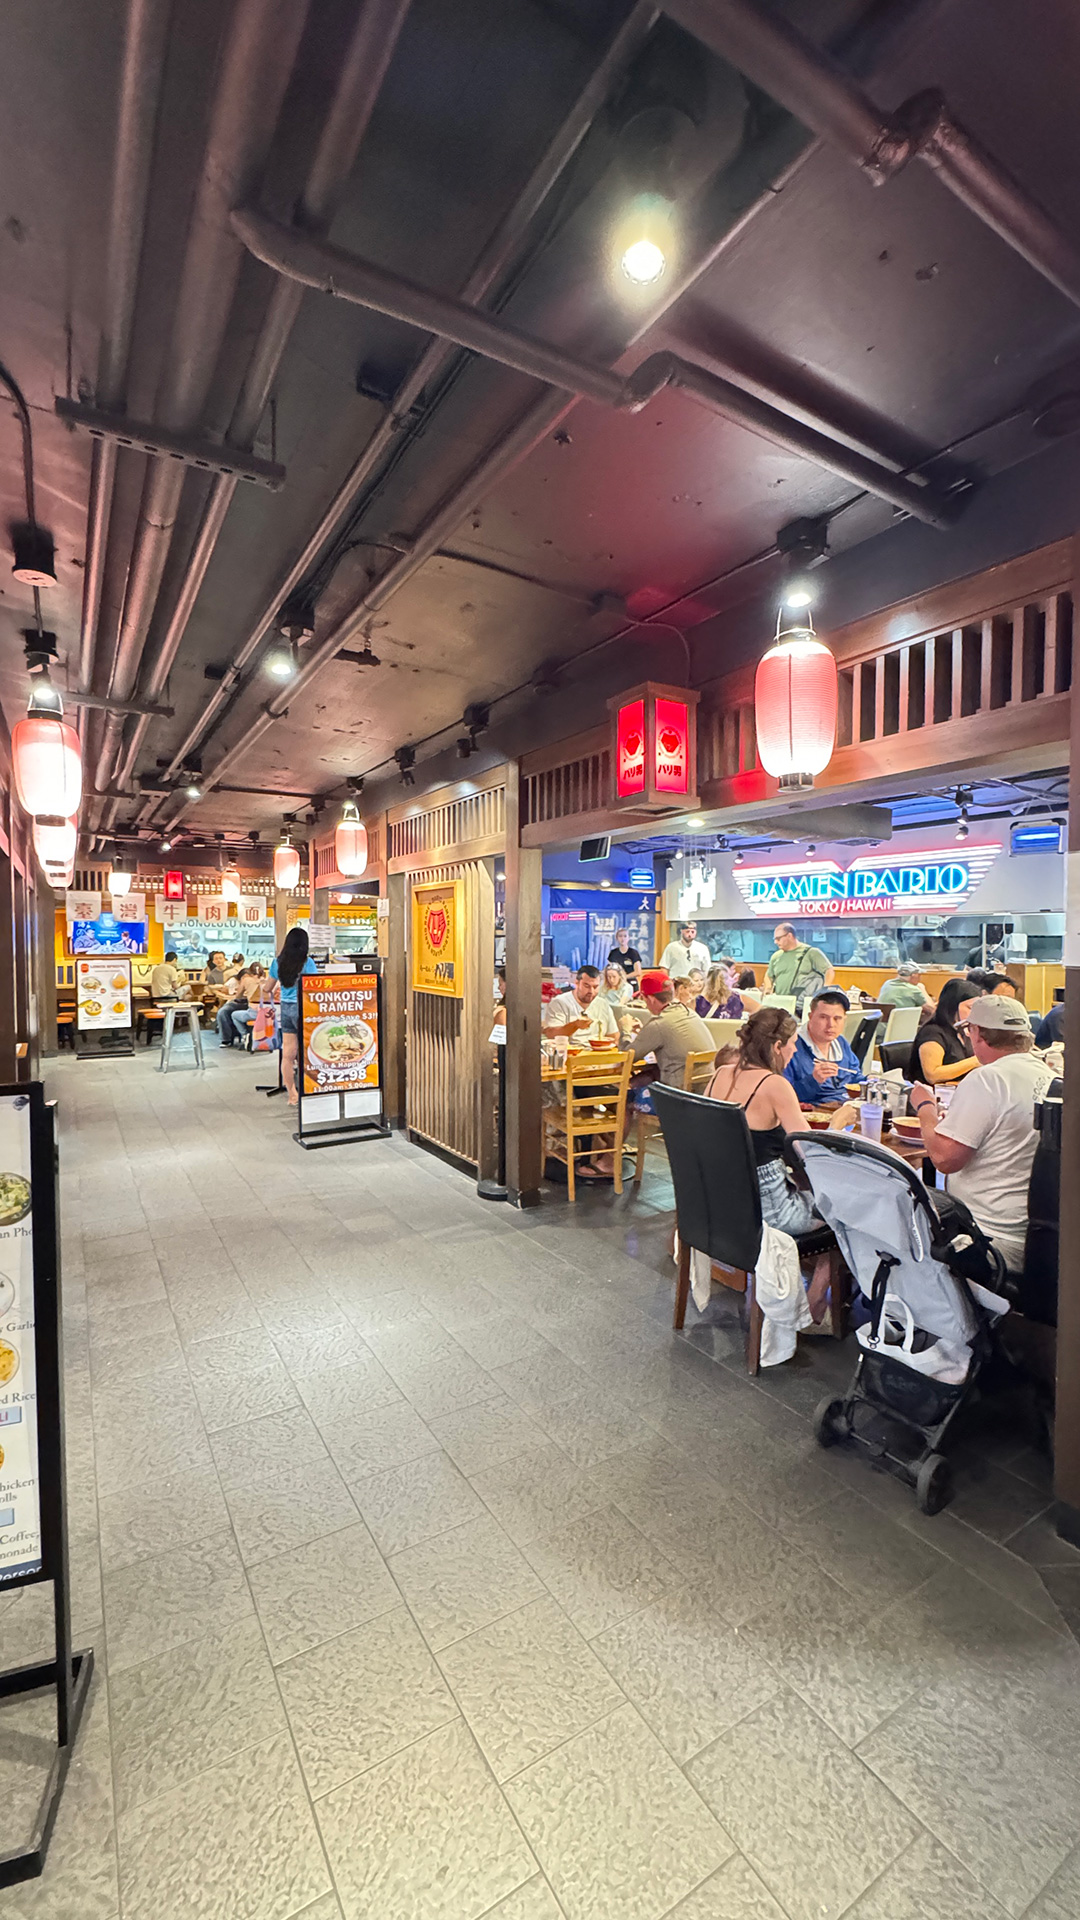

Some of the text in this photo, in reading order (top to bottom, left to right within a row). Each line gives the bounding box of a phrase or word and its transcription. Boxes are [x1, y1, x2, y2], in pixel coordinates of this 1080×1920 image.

[750, 863, 969, 900] RAMEN BARIO
[801, 901, 839, 914] TOKYO
[849, 898, 891, 911] HAWAII
[352, 977, 377, 985] BARIO
[308, 990, 372, 1003] TONKOTSU
[319, 1001, 364, 1013] RAMEN
[306, 1063, 329, 1071] Lunch
[317, 1069, 367, 1085] $12.98
[6, 1320, 36, 1332] Garli
[12, 1391, 36, 1403] Rice
[0, 1530, 40, 1545] Coffee,
